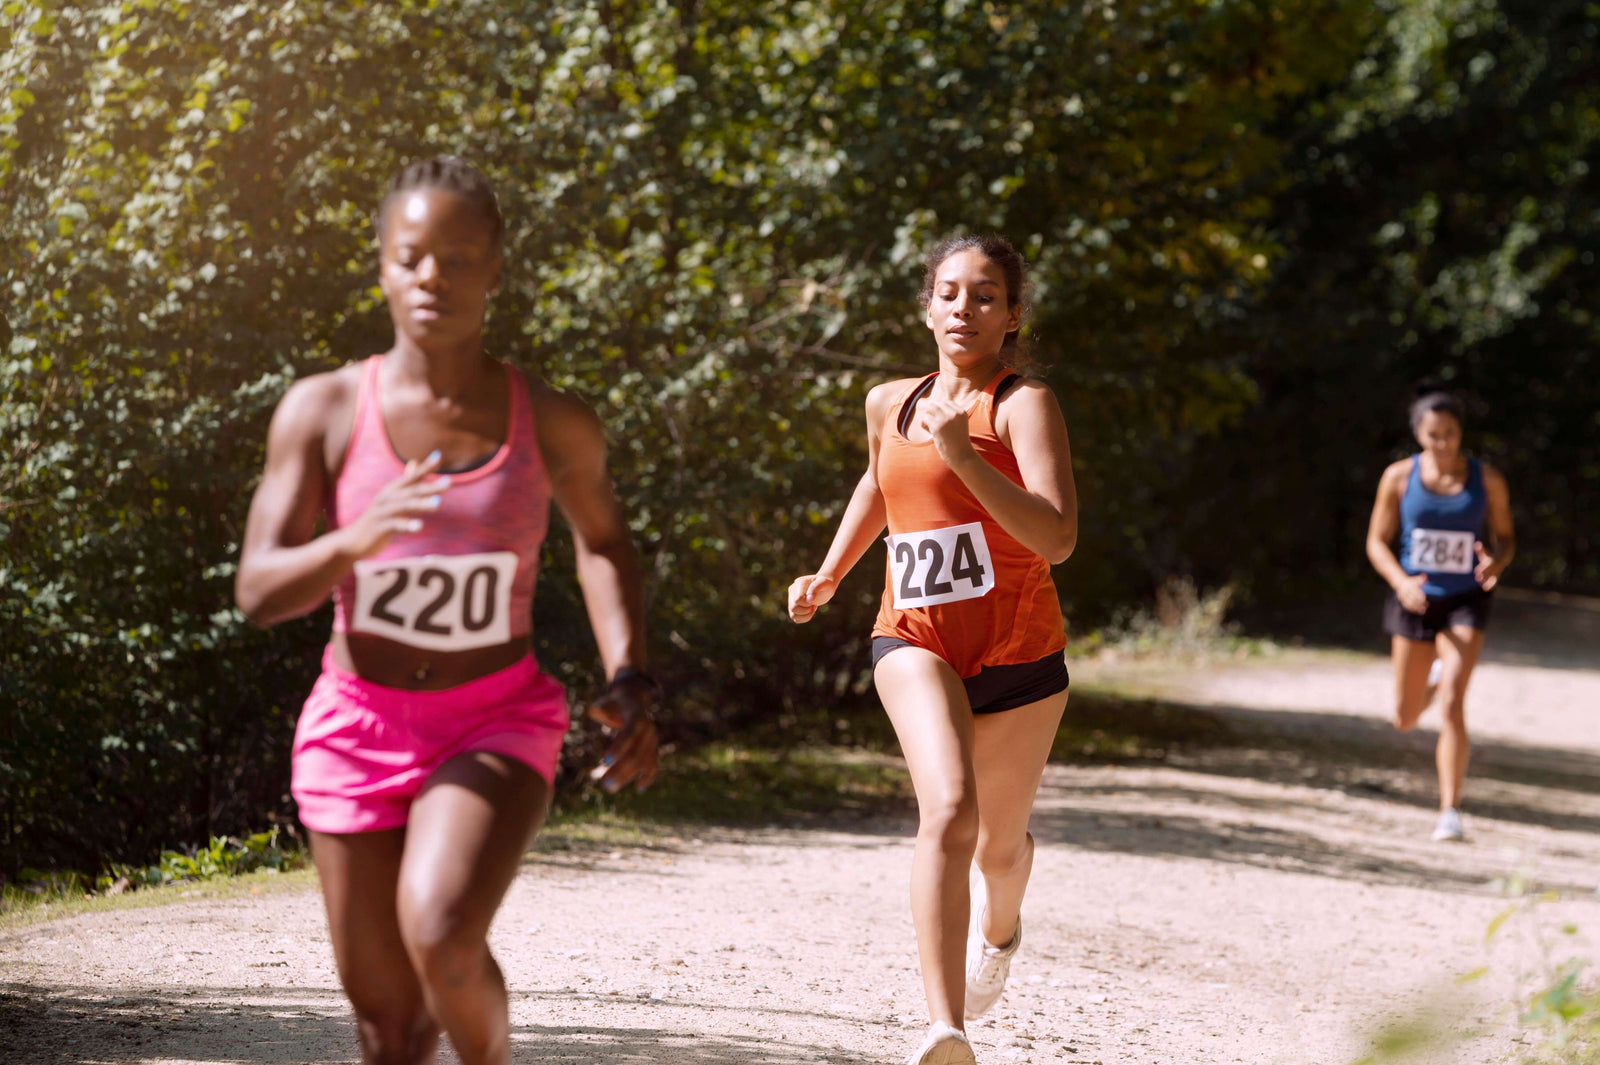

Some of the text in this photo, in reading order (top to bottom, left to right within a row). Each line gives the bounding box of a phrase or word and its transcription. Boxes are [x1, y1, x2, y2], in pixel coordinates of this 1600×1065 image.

[895, 532, 985, 600] 224
[1418, 537, 1465, 566] 284
[369, 565, 498, 636] 220
